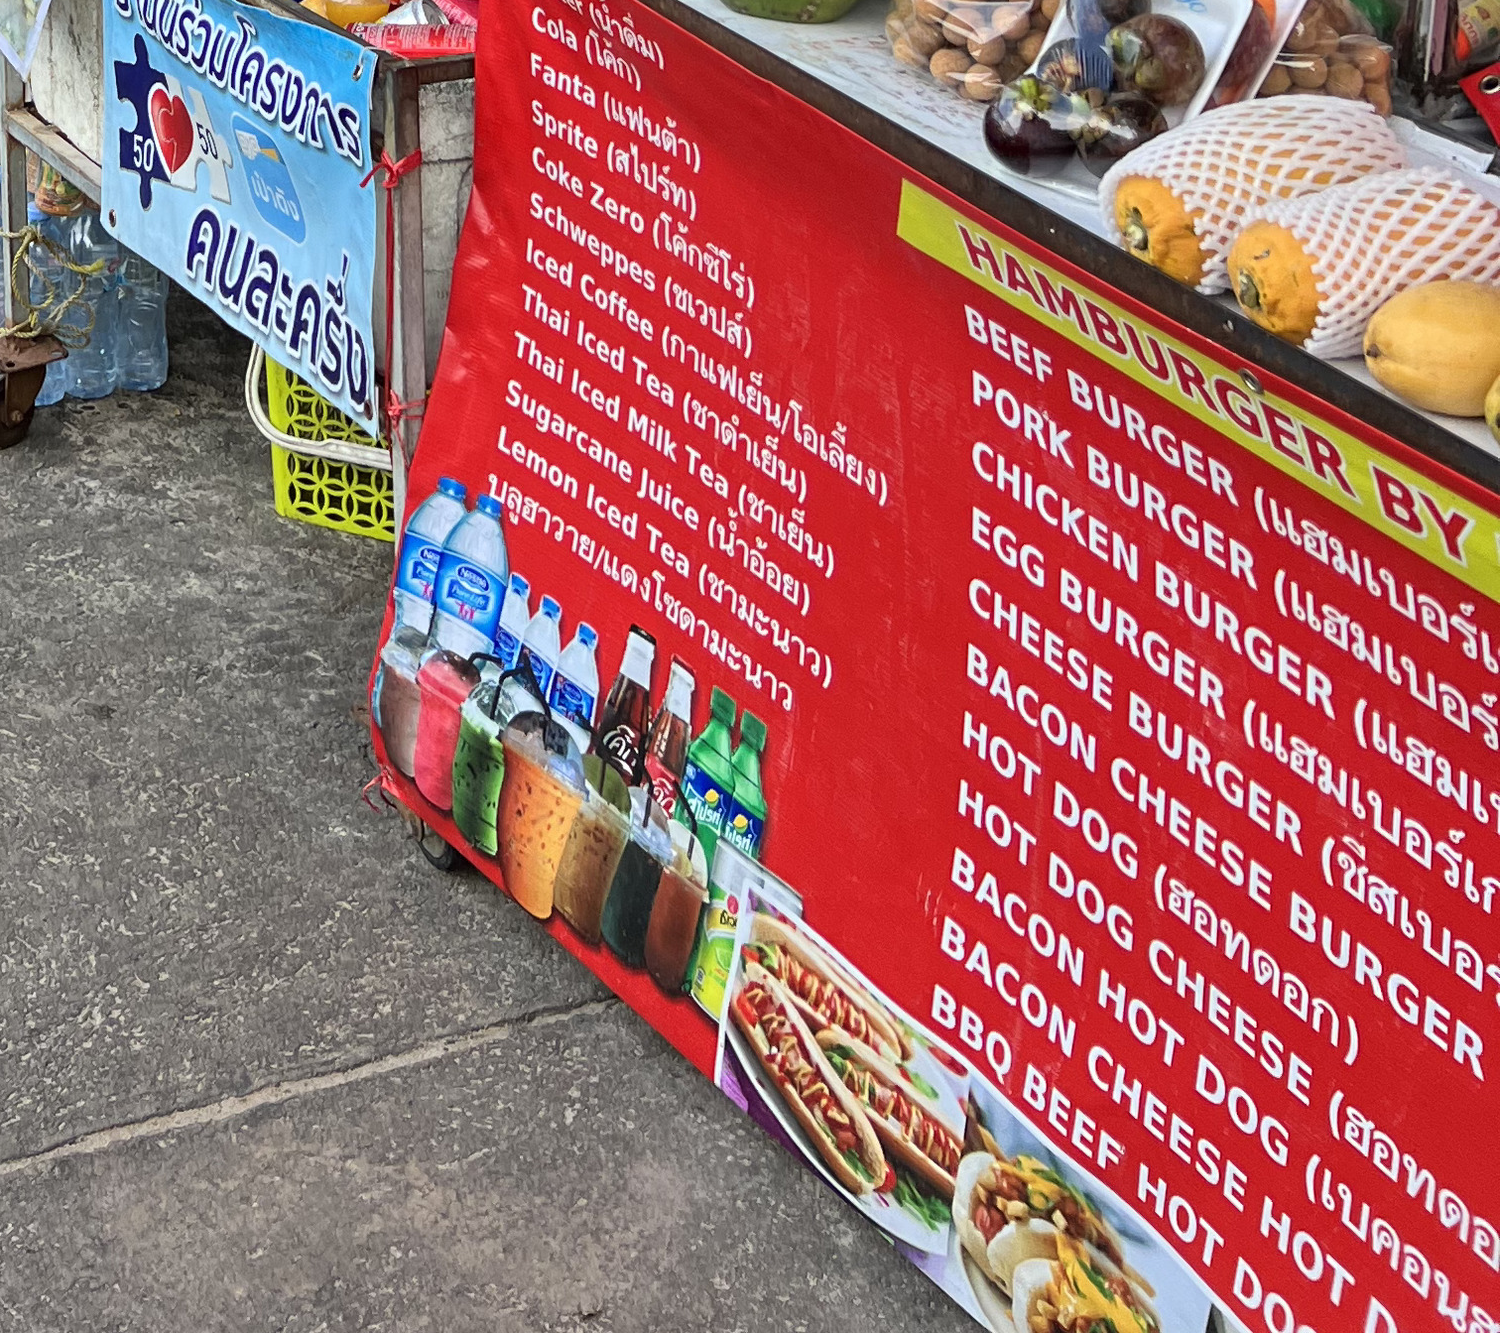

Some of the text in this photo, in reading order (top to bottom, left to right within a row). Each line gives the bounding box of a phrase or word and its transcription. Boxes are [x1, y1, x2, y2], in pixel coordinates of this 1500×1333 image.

[133, 134, 155, 172] 50
[196, 122, 218, 161] 50
[530, 52, 701, 173] Fanta (แฟนต้า)
[531, 6, 578, 52] Cola
[584, 28, 642, 92] (โค้ก)
[531, 99, 697, 221] Sprite (สไปร์ท)
[186, 207, 369, 410] คนละครึ่ง
[525, 238, 573, 288] Iced
[580, 273, 654, 341] Coffee
[529, 192, 656, 291] Schweppes
[531, 147, 755, 309] Coke Zero (โค้กซีโร่)
[505, 378, 811, 617] Sugarcane Juice (น้ำอ้อย)
[513, 331, 835, 579] Thai Iced Milk Tea (ชาเย็น)
[522, 283, 808, 504] Thai Iced Tea (ชาดำเย็น)
[956, 220, 1474, 567] HAMBURGER BY
[964, 304, 1500, 675] BEEF BURGER (แฮมเบอร์เ
[972, 370, 1075, 469] PORK
[1087, 445, 1257, 591] BURGER
[497, 425, 833, 690] Lemon Iced Tea (ชามะนาว)
[972, 442, 1138, 582] CHICKEN
[1155, 560, 1336, 720] BURGER
[972, 506, 1045, 588] EGG
[1060, 568, 1226, 720] BURGER
[968, 578, 1113, 711] CHEESE
[1130, 691, 1303, 857] BURGER
[958, 779, 1037, 866] HOT
[1049, 852, 1134, 952] DOG
[1149, 939, 1312, 1106] CHEESE
[962, 710, 1359, 1066] HOT DOG (ฮอทดอก)
[967, 643, 1484, 1082] BACON CHEESE BURGER
[940, 916, 1076, 1058] BACON
[1088, 1045, 1247, 1212] CHEESE
[1260, 1196, 1355, 1307] HOT
[951, 846, 1085, 987] BACON
[1098, 968, 1185, 1067] HOT
[1195, 1054, 1289, 1167] DOG
[931, 984, 1319, 1333] BBQ BEEF HOT DO
